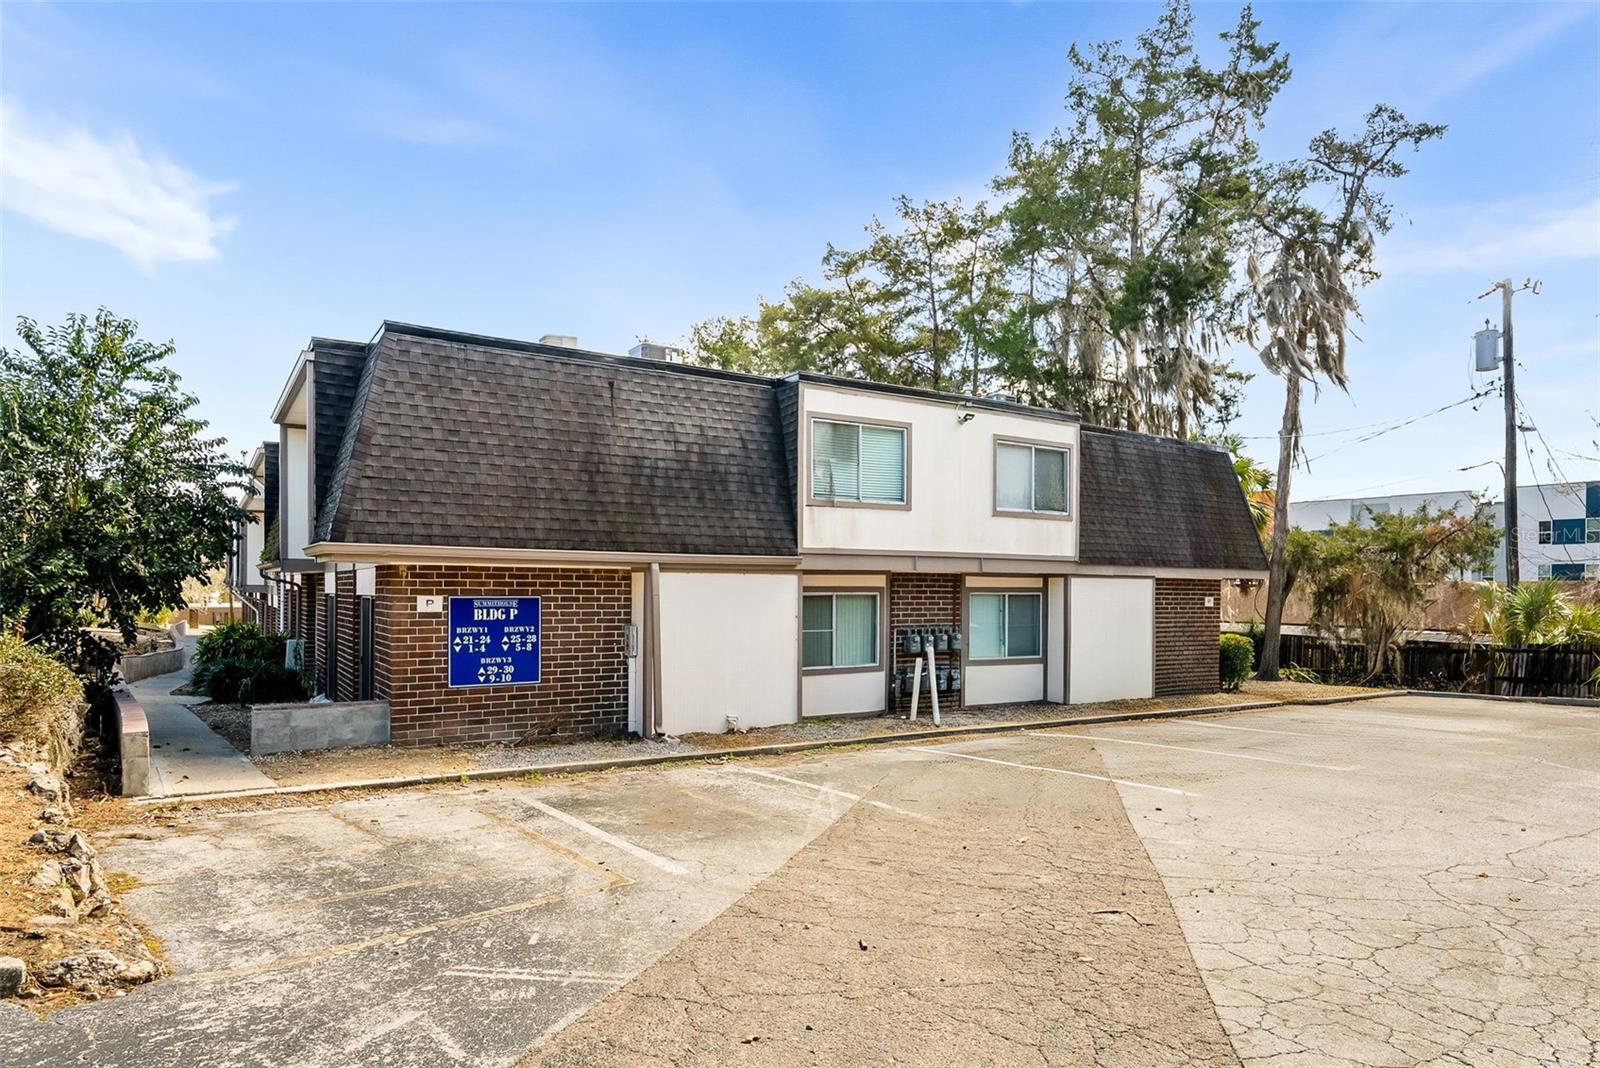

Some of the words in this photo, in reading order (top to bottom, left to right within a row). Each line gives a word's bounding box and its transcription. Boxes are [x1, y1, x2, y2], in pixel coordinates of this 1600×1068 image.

[426, 599, 434, 607] P
[474, 608, 506, 621] BLDG
[510, 608, 518, 620] P
